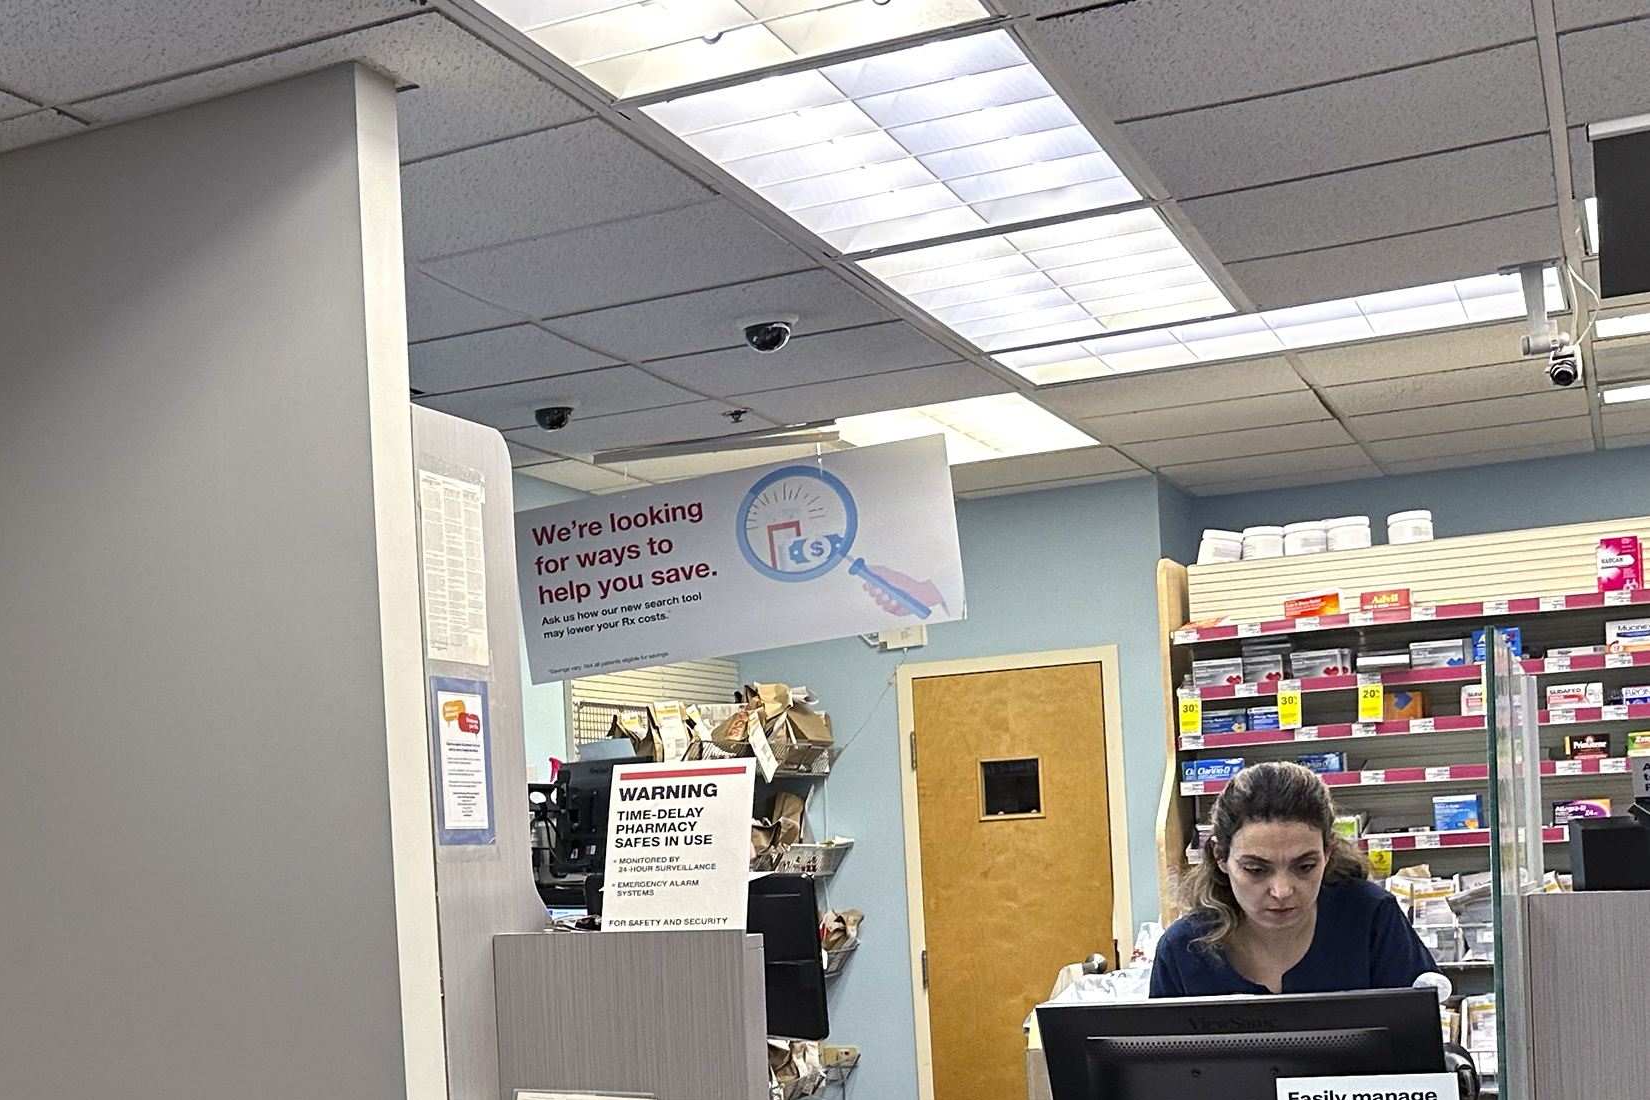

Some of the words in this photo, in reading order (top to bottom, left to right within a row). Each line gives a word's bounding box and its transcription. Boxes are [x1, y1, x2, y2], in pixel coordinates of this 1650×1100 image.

[531, 520, 603, 547] We're
[609, 501, 704, 533] looking
[534, 555, 570, 576] for
[575, 543, 641, 569] ways
[647, 535, 674, 556] to
[538, 581, 592, 606] help
[597, 574, 644, 600] you
[650, 562, 718, 585] save.
[1372, 593, 1399, 604] Advil
[541, 612, 560, 627] Ask
[562, 612, 575, 624] us
[577, 608, 599, 622] how
[602, 606, 619, 618] our
[620, 603, 641, 616] new
[644, 595, 680, 613] search
[682, 591, 702, 607] tool
[543, 629, 564, 641] may
[566, 622, 595, 637] lower
[596, 620, 620, 636] your
[621, 615, 636, 628] Rx
[1197, 766, 1231, 775] Claritin-D
[618, 782, 719, 802] WARNING
[617, 806, 705, 822] TIME-DELAY
[616, 820, 698, 836] PHARMACY
[614, 836, 661, 849] SAFES
[664, 835, 680, 847] IN
[683, 833, 714, 846] USE
[617, 864, 653, 874] 24-HOUR
[655, 862, 717, 872] SURVEILLANCE
[618, 856, 668, 865] MONITORED
[669, 855, 681, 864] BY
[617, 880, 668, 889] EMERGENCY
[669, 879, 700, 888] ALARM
[616, 889, 655, 897] SYSTEMS
[608, 919, 626, 928] FOR
[628, 918, 662, 927] SAFETY
[663, 918, 682, 926] AND
[683, 916, 728, 926] SECURITY
